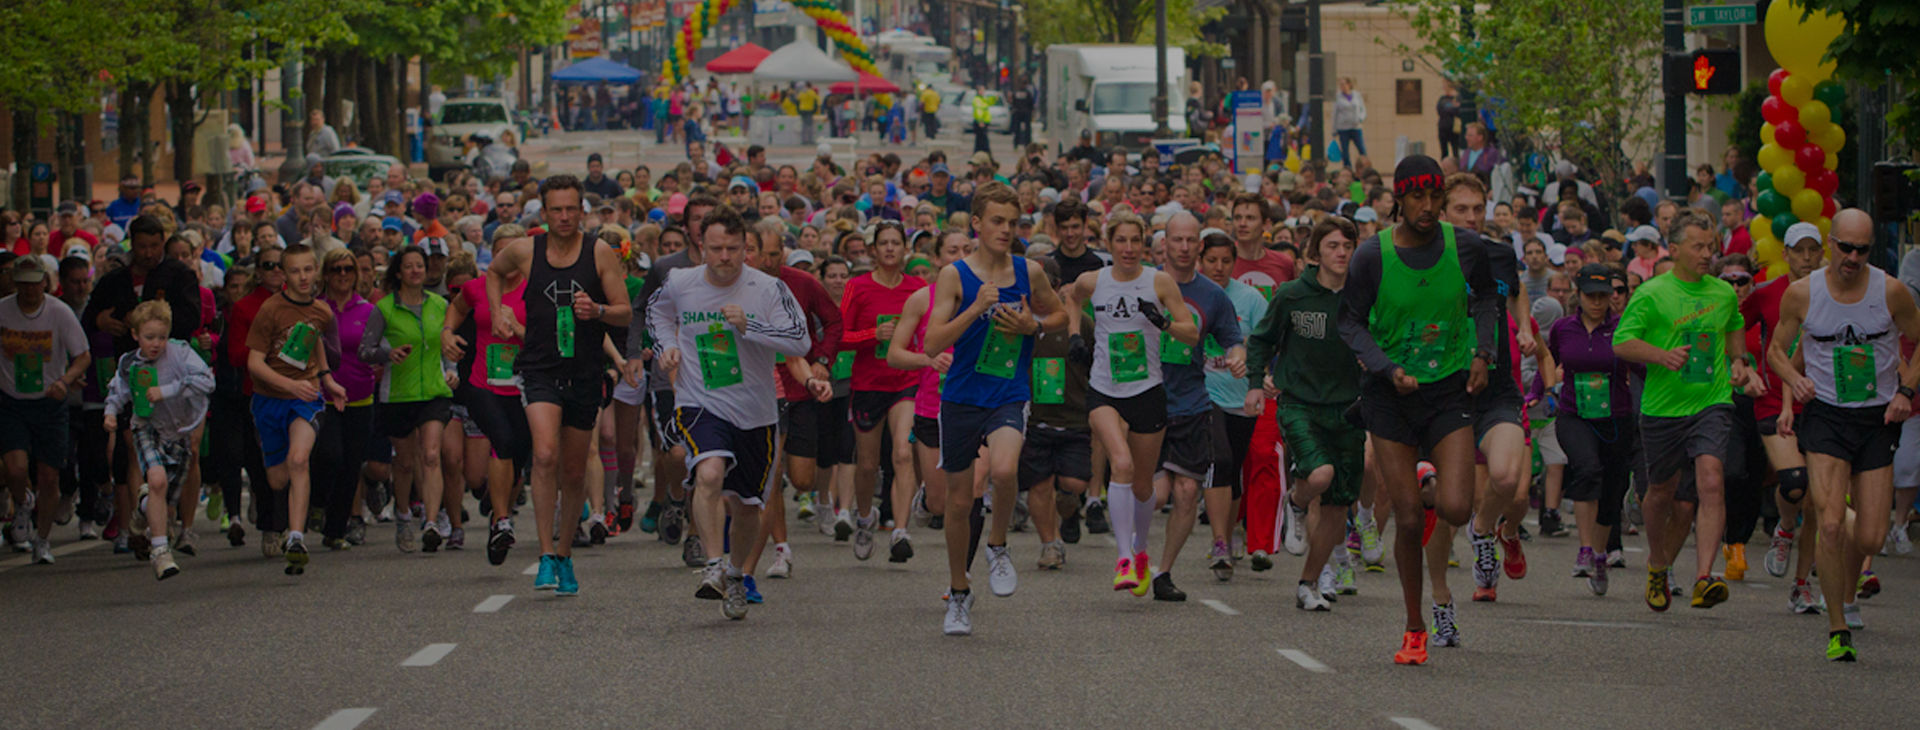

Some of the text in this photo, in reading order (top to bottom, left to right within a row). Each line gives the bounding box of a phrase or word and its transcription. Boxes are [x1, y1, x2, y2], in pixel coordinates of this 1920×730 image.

[1692, 10, 1705, 23] SW
[1714, 8, 1746, 21] TAYLOR
[683, 311, 755, 325] SHAMR
[1674, 303, 1714, 326] PORTLAND
[1838, 349, 1846, 394] 1553
